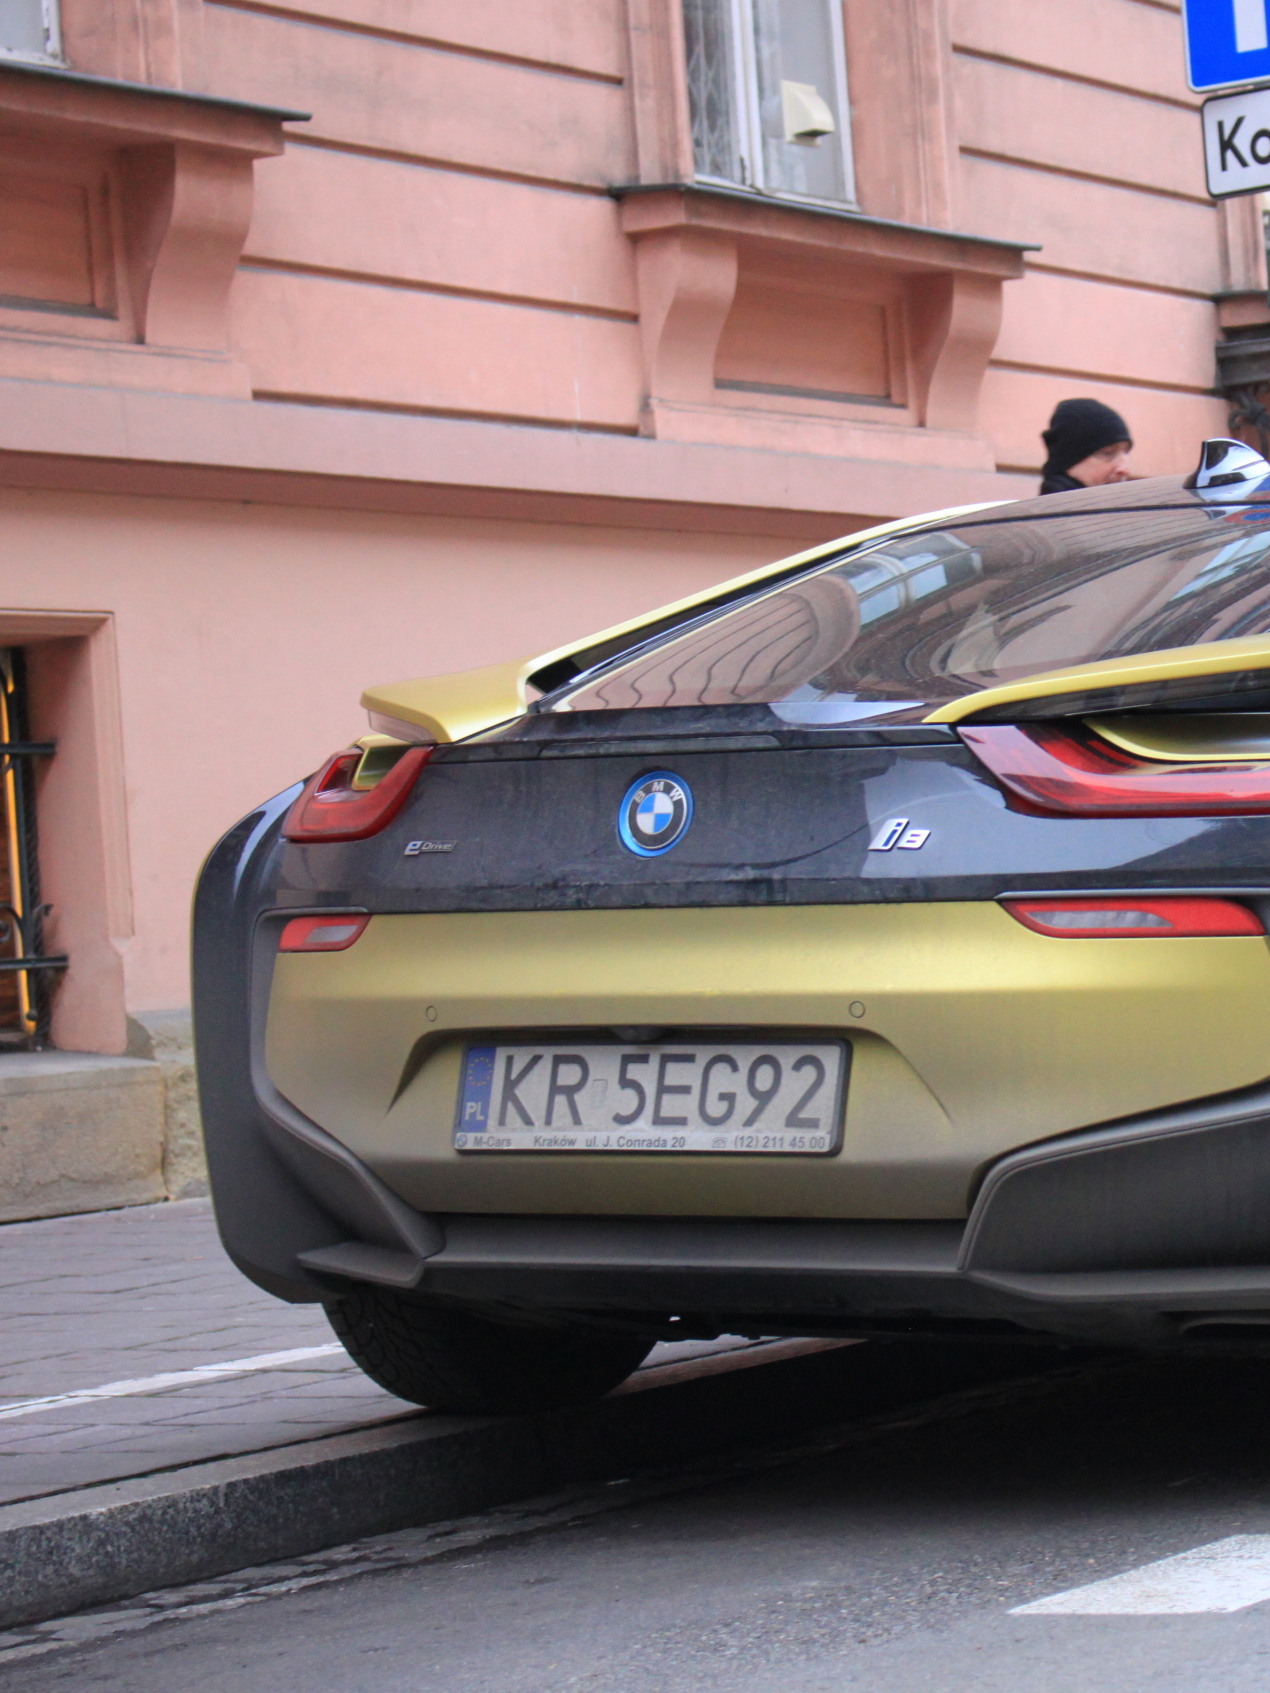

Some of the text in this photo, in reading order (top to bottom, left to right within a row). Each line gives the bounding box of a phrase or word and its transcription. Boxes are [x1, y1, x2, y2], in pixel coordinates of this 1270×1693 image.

[634, 781, 683, 803] BMW
[867, 818, 931, 851] i8
[498, 1053, 826, 1128] KR 5EG92
[465, 1102, 485, 1121] PL
[473, 1136, 512, 1148] M-Cars
[533, 1135, 577, 1148] Kraków
[585, 1136, 598, 1148] ul.
[616, 1136, 668, 1148] Conrada
[671, 1136, 686, 1148] 20
